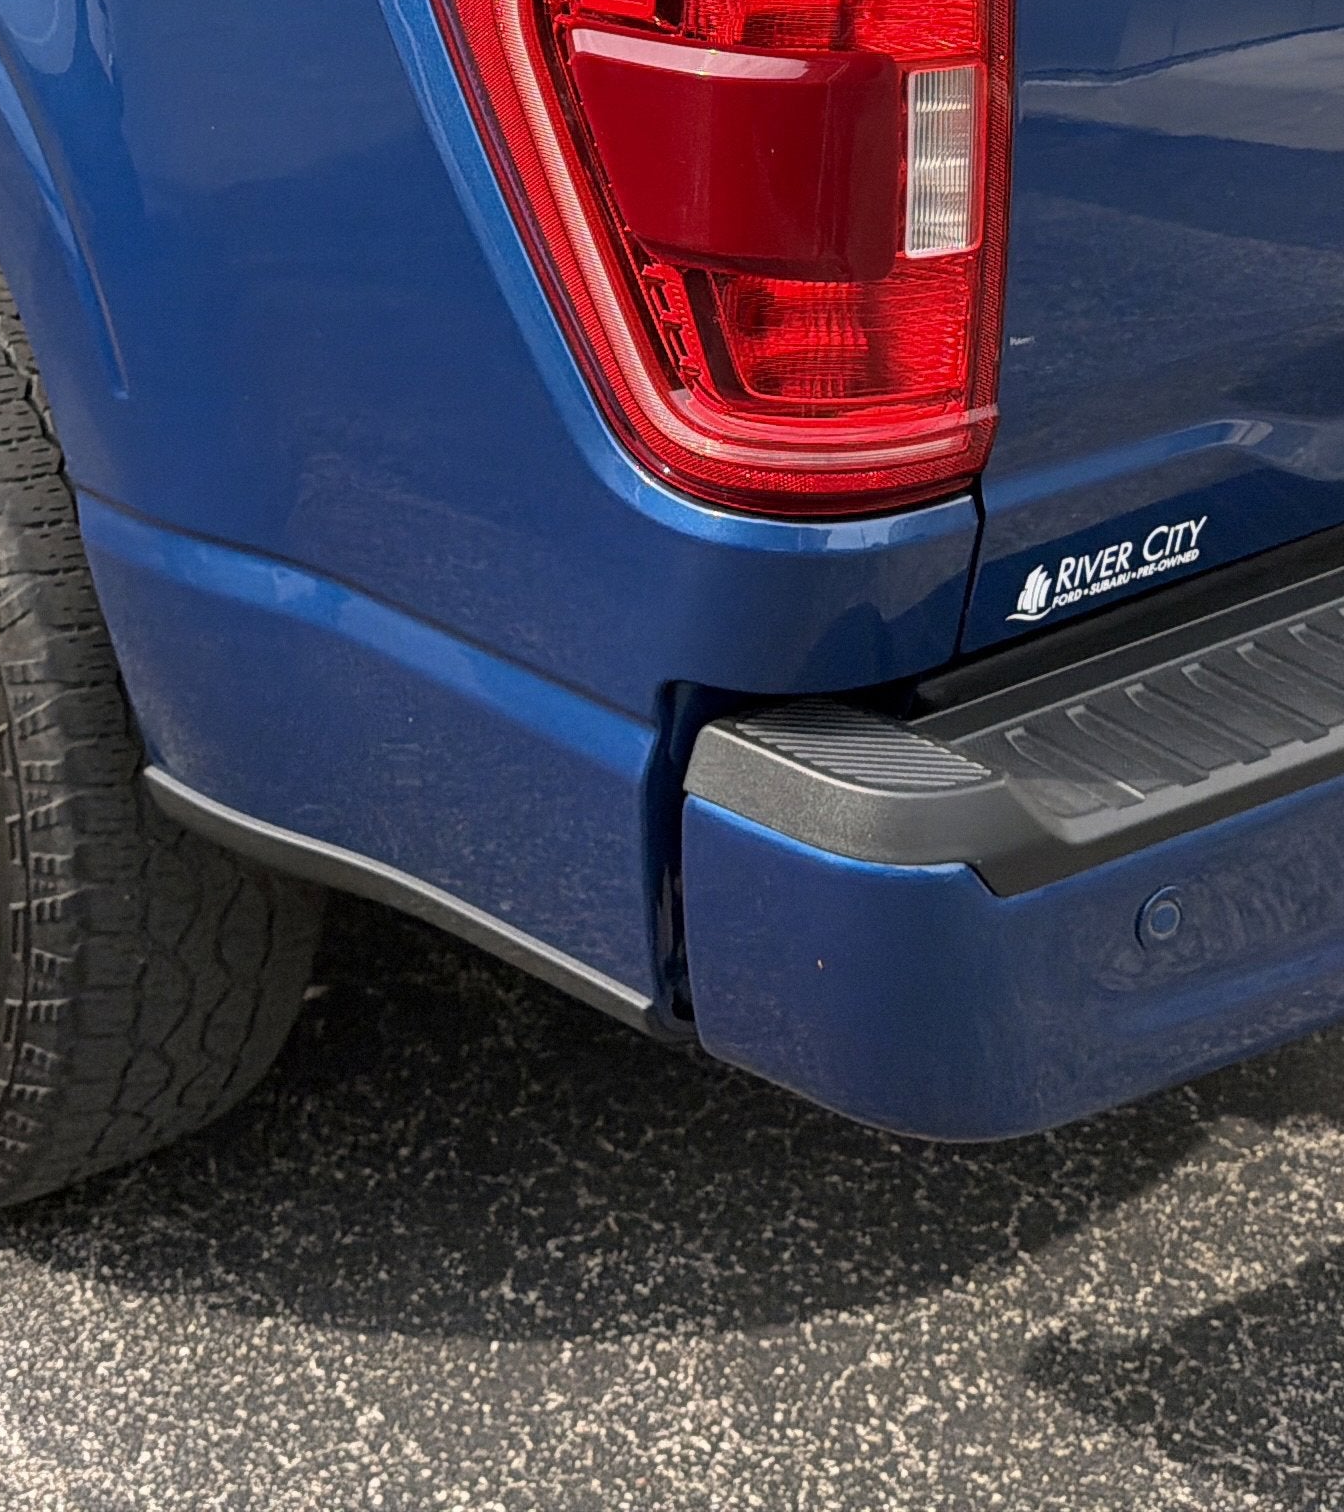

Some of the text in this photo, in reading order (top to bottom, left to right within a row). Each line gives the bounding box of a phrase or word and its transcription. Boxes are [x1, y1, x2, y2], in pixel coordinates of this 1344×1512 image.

[1052, 549, 1199, 608] FORD SUBARU PRE-OWNED
[1056, 516, 1207, 593] RIVER CITY
